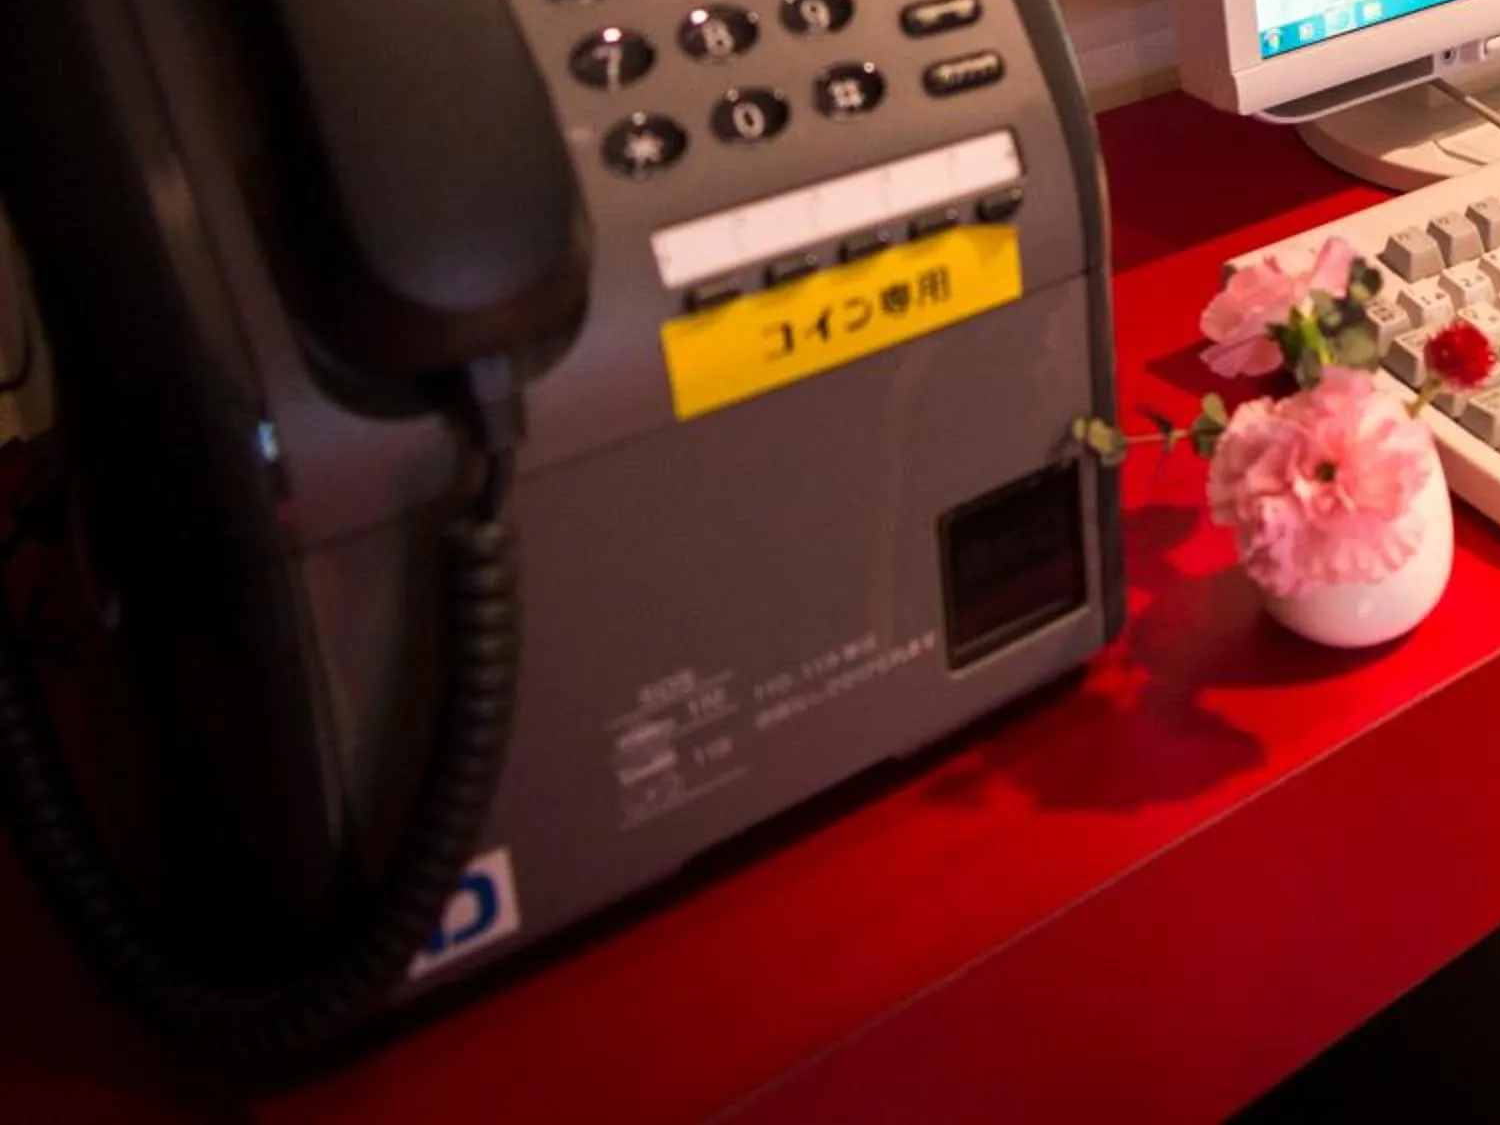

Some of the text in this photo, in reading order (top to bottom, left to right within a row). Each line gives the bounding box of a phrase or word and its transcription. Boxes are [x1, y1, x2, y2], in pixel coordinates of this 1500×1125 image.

[760, 263, 952, 364] コイン専用
